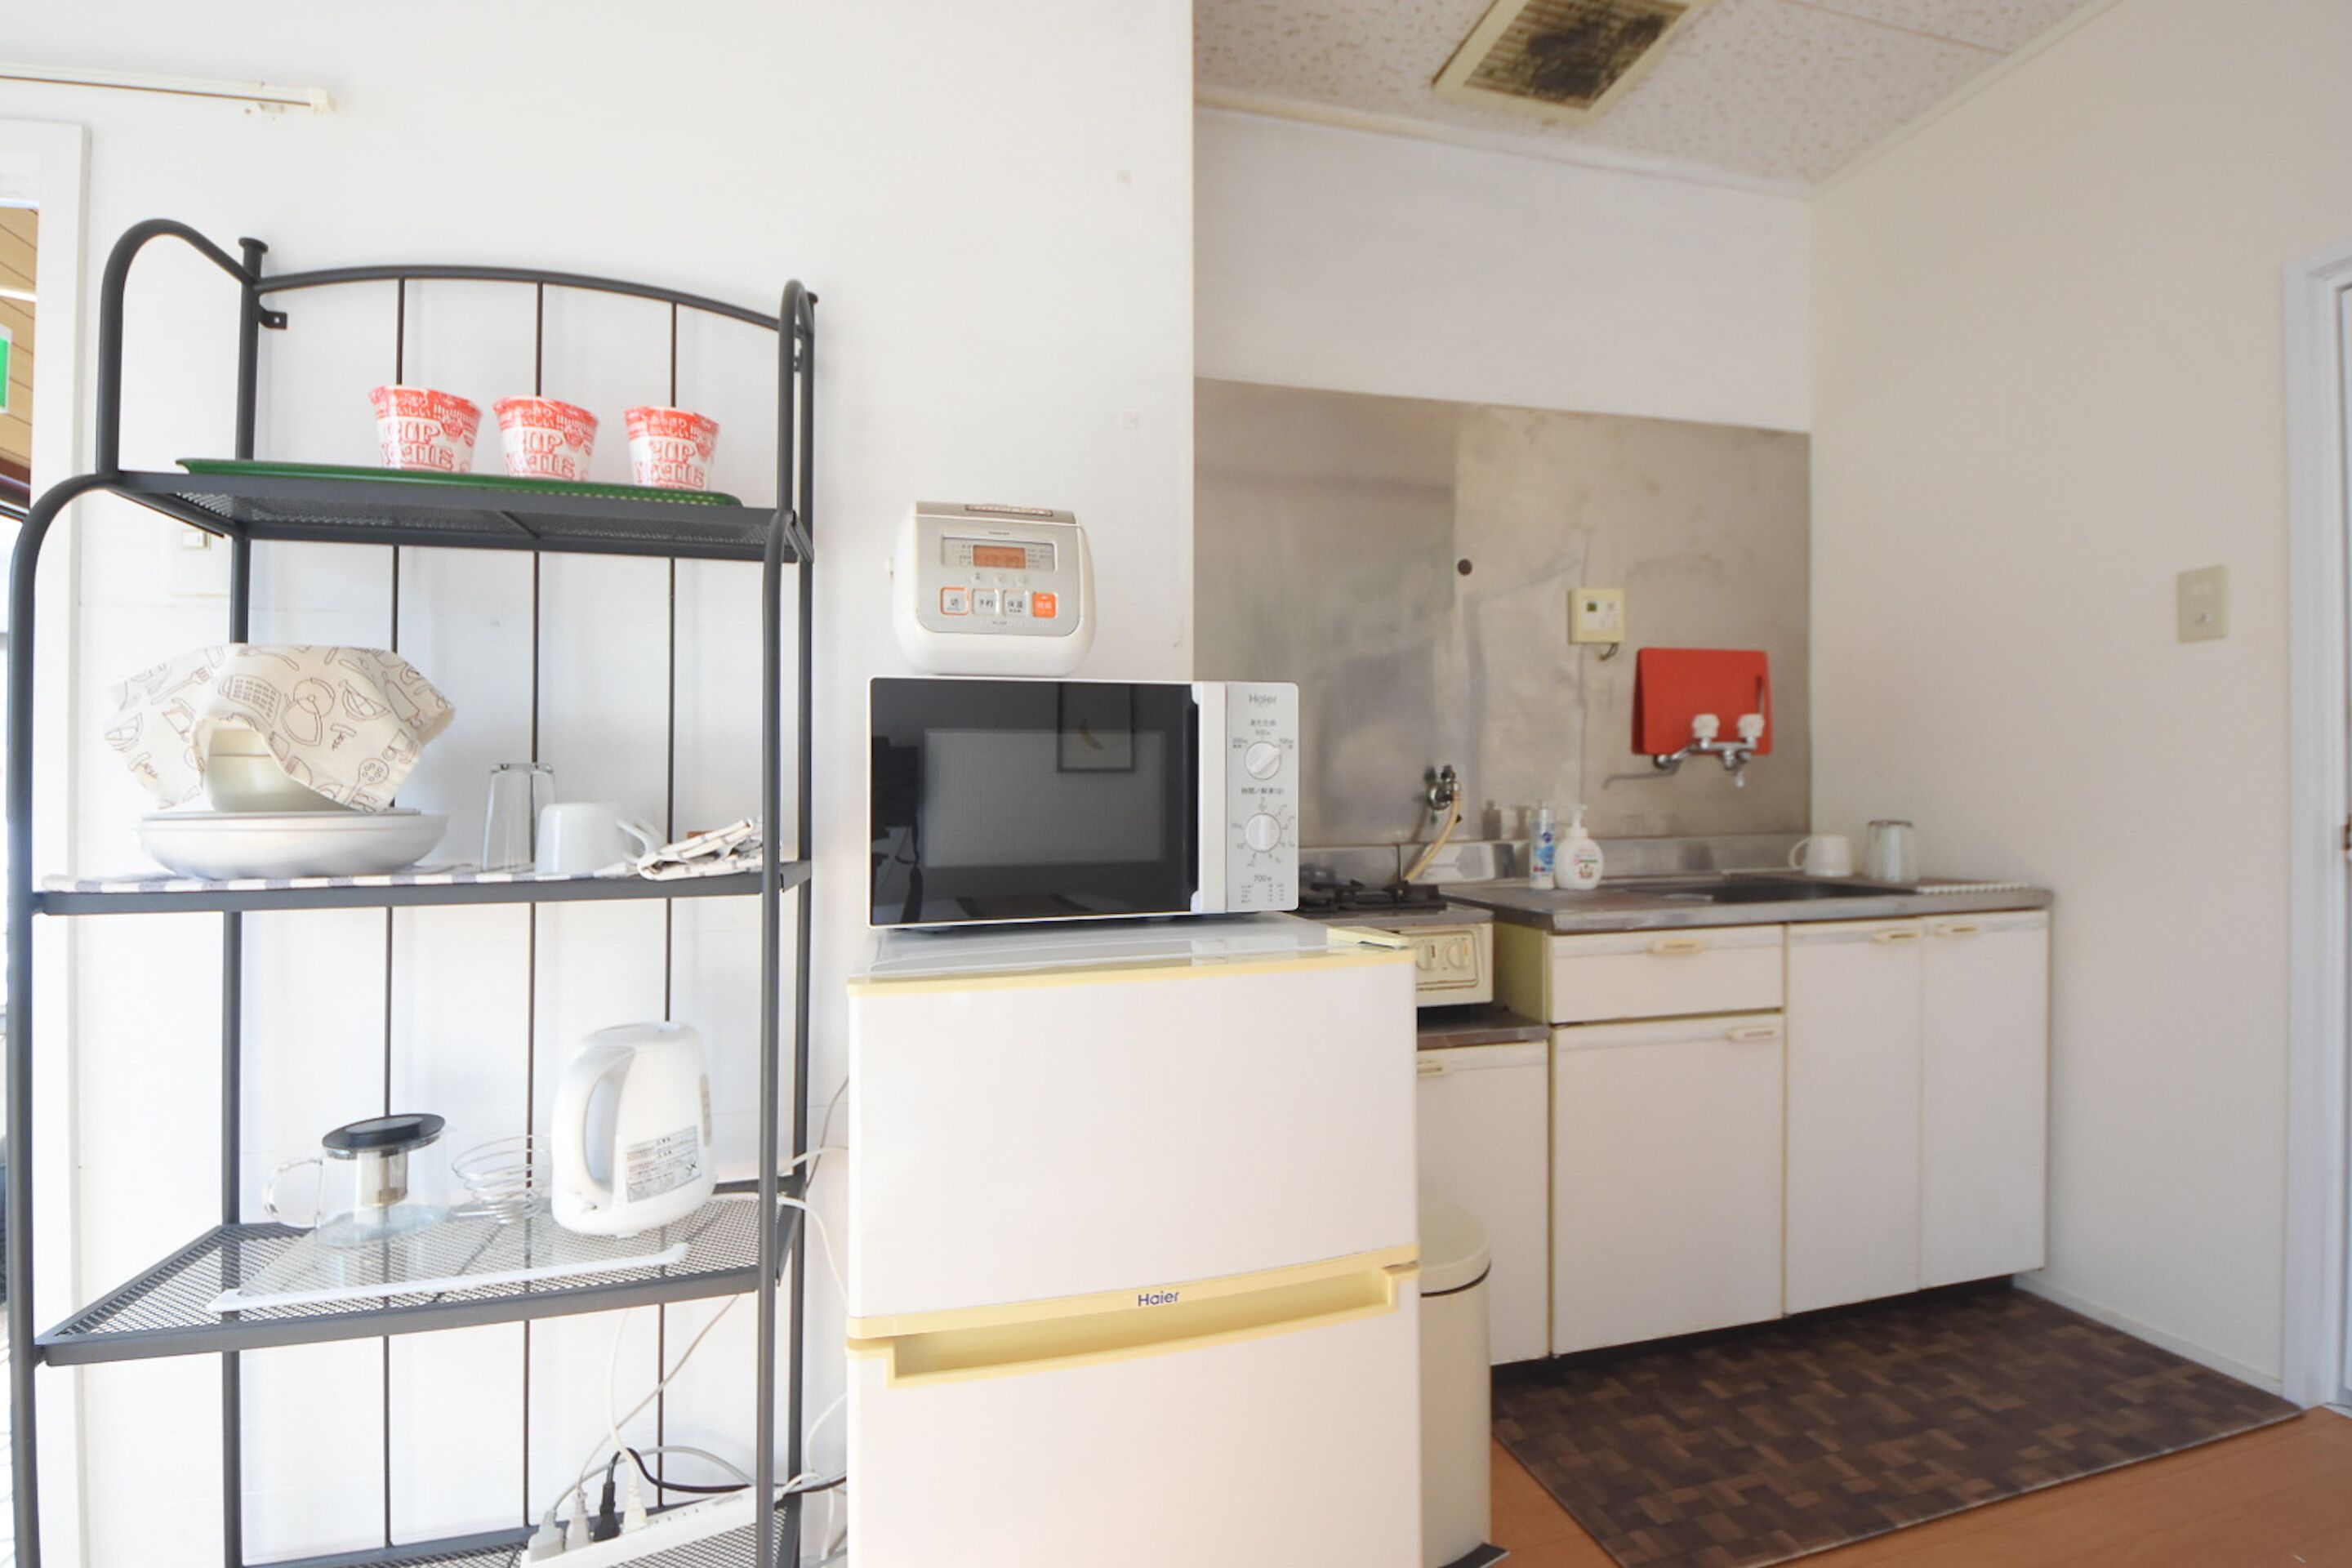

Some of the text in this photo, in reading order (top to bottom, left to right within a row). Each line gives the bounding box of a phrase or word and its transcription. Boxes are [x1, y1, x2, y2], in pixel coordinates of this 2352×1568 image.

[511, 429, 564, 455] UP
[1249, 693, 1277, 704] Haier
[1138, 1290, 1179, 1307] Haier
